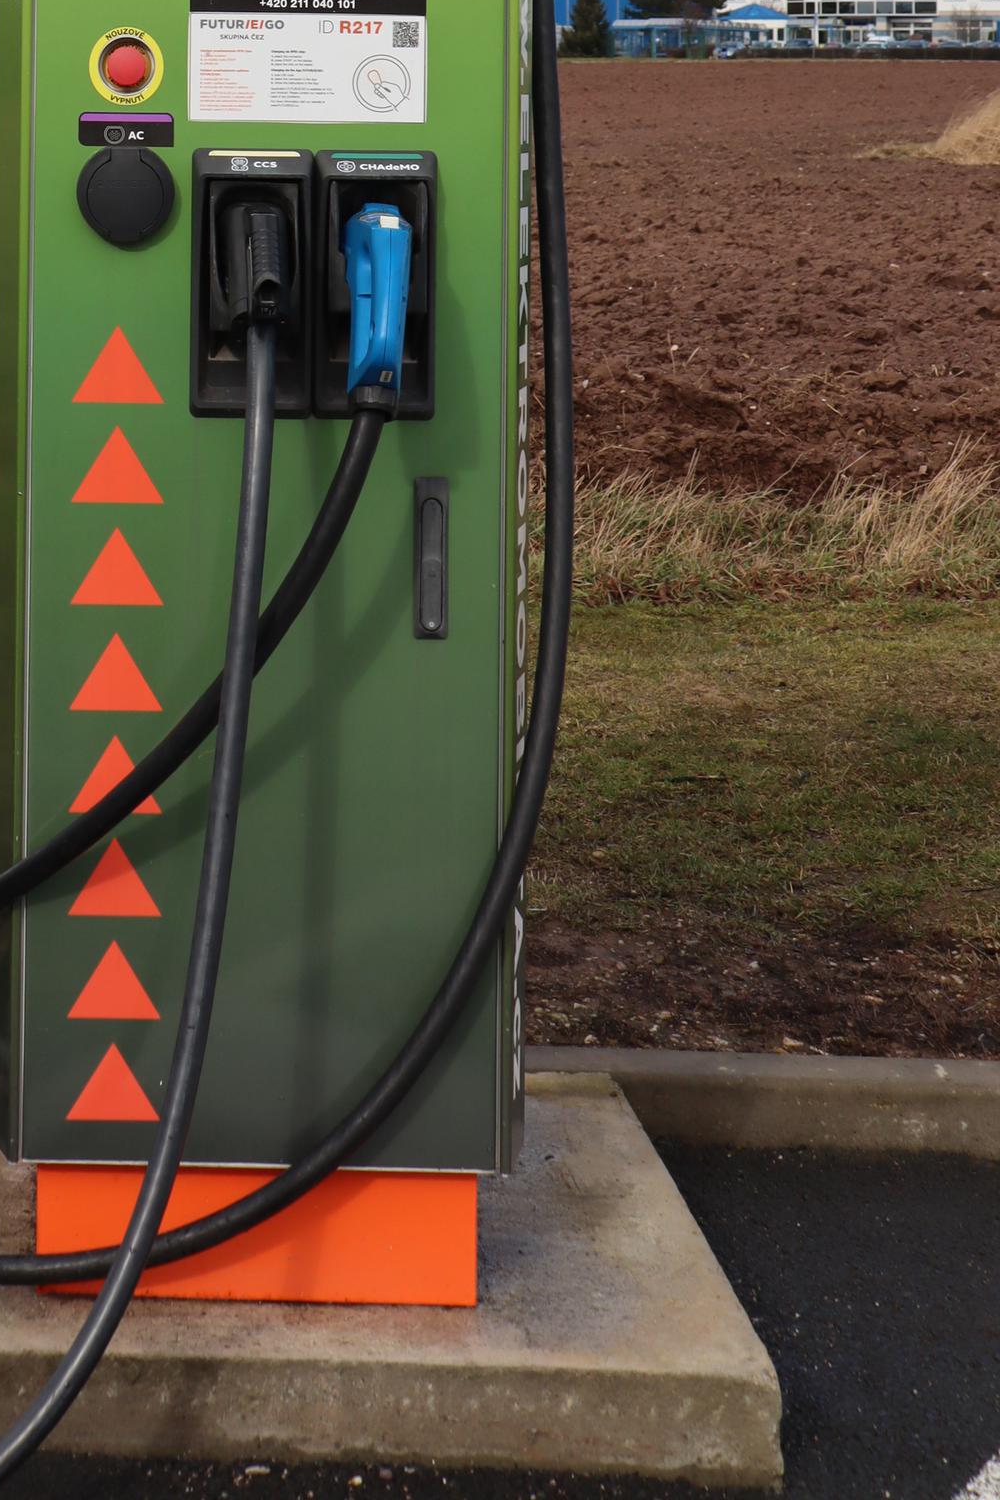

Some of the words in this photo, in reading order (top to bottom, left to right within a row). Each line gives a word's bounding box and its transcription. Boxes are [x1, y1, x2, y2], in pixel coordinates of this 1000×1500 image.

[259, 0, 287, 8] +420
[291, 0, 308, 8] 211
[313, 0, 333, 8] 040
[337, 0, 356, 9] 101
[200, 19, 285, 30] FUTUR/E/GO
[319, 20, 334, 34] ID
[340, 21, 383, 34] R217
[251, 32, 265, 40] ČEZ
[128, 131, 145, 140] AC
